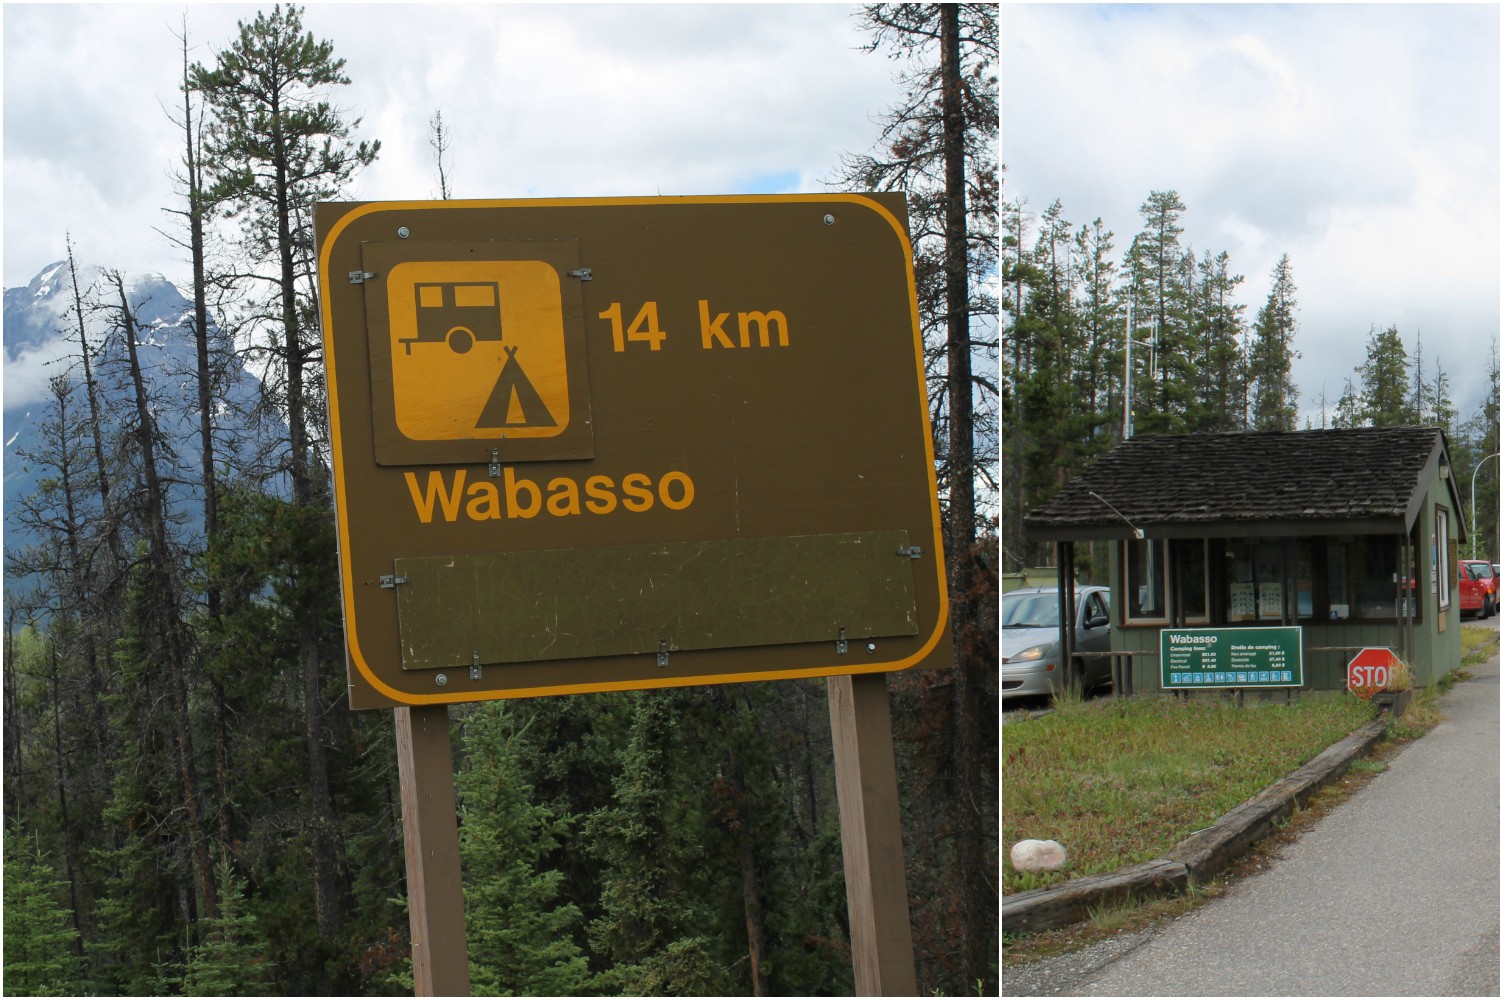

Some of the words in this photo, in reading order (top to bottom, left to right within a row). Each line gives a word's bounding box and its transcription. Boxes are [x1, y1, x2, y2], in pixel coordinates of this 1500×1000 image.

[599, 301, 667, 353] 14
[698, 300, 789, 350] km
[404, 467, 695, 523] Wabasso
[1170, 635, 1217, 643] Wabasso
